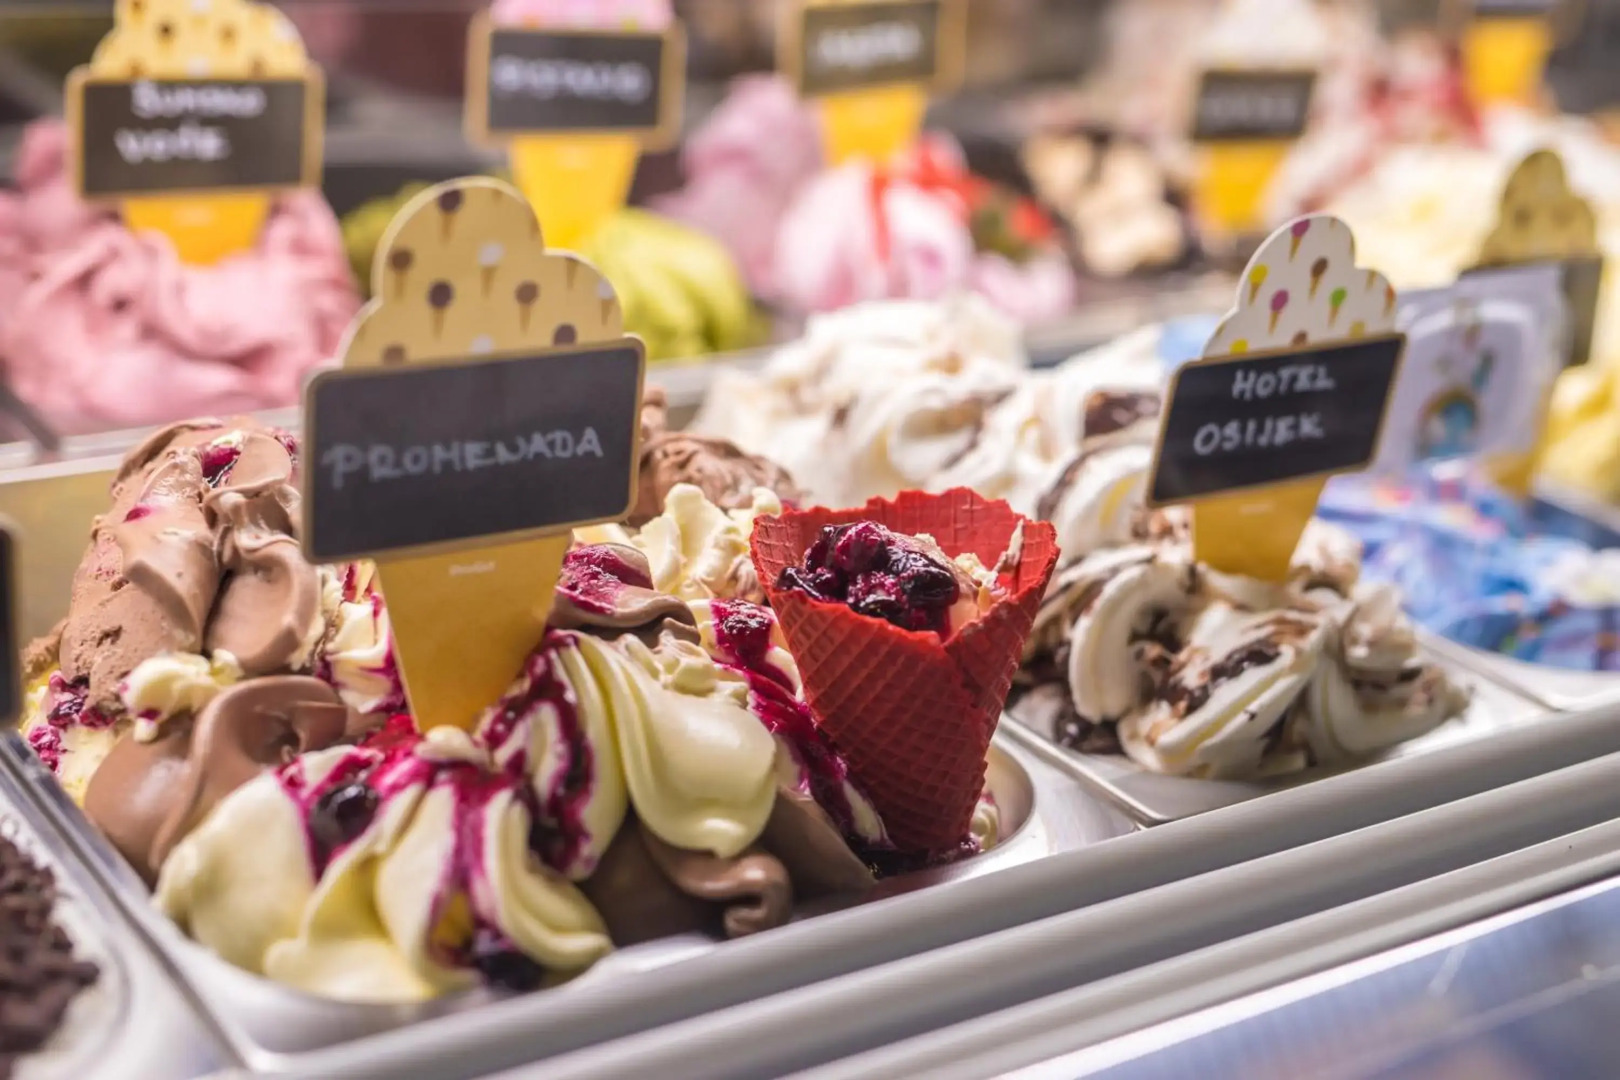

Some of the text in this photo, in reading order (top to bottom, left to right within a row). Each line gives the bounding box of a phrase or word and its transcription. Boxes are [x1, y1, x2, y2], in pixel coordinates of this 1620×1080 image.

[1232, 365, 1335, 400] HOTEL
[1193, 412, 1324, 455] OSIJEK
[322, 426, 604, 489] PROMENADA
